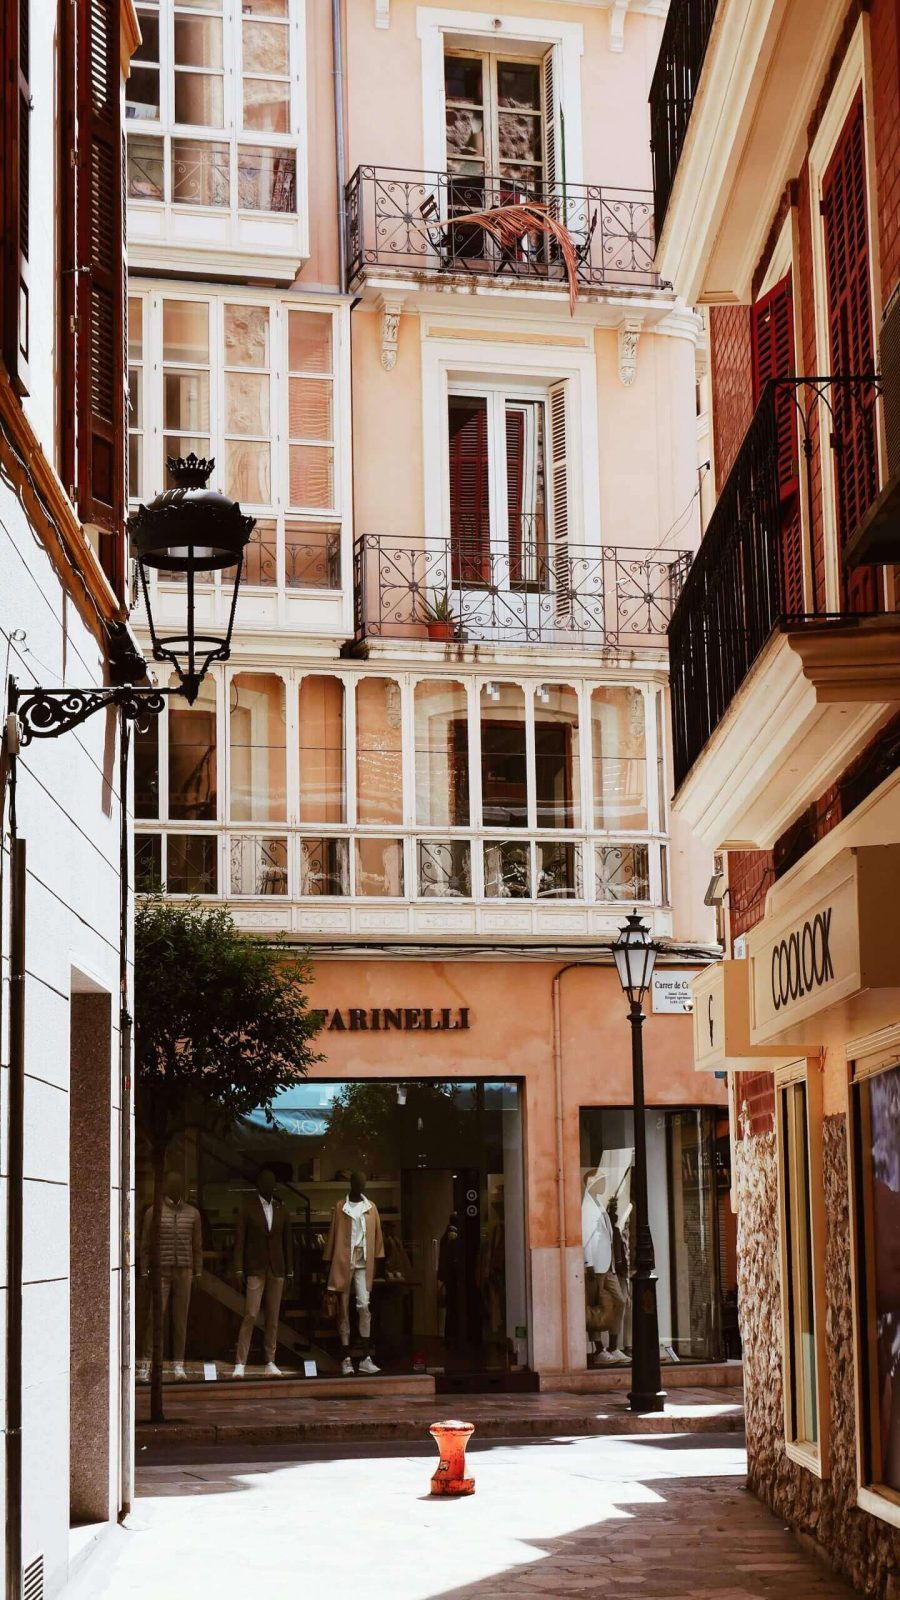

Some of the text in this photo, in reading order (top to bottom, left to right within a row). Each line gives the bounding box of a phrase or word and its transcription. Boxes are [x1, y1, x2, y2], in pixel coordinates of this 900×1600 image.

[655, 981, 673, 989] Carrer
[674, 981, 680, 989] de
[771, 907, 834, 1010] COOLOOK
